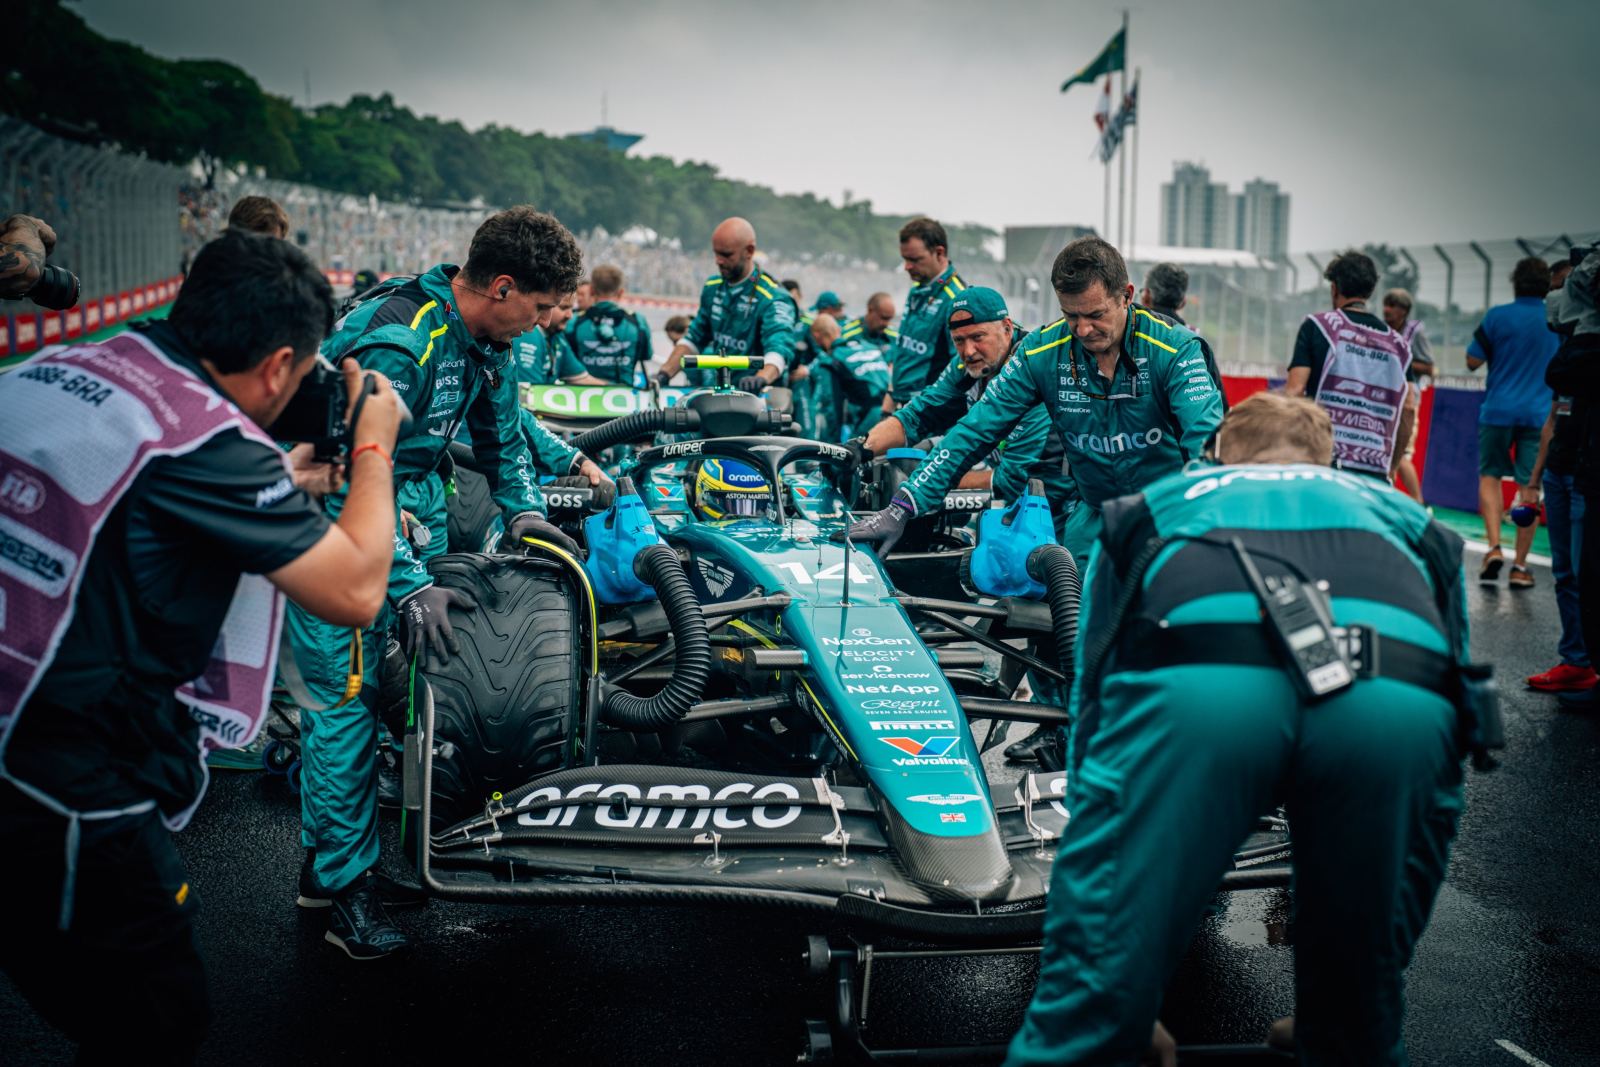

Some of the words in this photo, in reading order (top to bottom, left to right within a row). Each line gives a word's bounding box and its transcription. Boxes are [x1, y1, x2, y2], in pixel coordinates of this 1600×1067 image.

[390, 379, 410, 391] xGen
[543, 387, 684, 412] aram
[1064, 427, 1163, 454] aramco
[912, 448, 951, 489] ramco
[726, 492, 747, 500] ASTON
[748, 492, 770, 500] MARTIN
[944, 496, 983, 510] BOSS
[778, 562, 874, 585] 14
[821, 636, 911, 646] NexGen
[829, 649, 916, 657] VELOCITY
[846, 684, 940, 695] NetApp
[868, 720, 956, 731] PIRELLI
[516, 782, 802, 829] aramco
